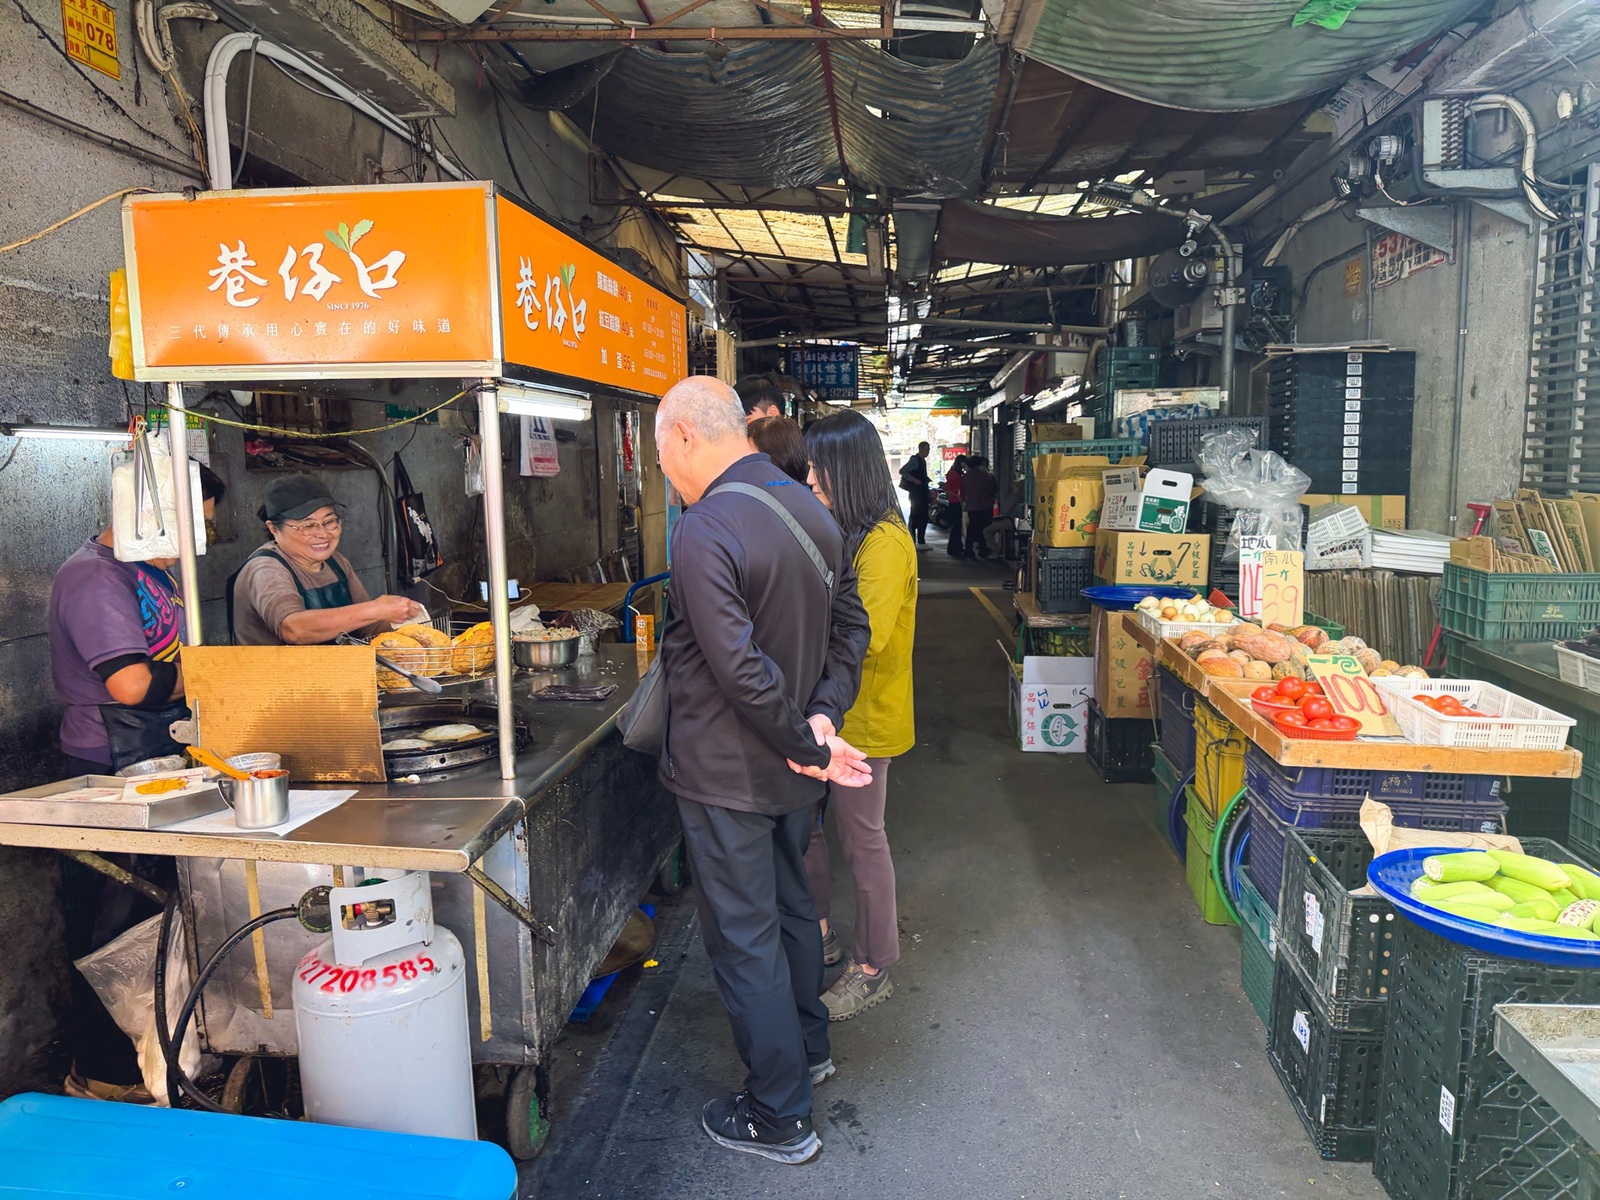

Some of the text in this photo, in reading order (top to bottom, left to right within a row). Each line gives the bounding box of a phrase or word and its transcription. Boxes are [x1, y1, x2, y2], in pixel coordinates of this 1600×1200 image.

[86, 22, 114, 51] 078
[207, 239, 406, 307] 巷仔口
[326, 302, 369, 310] SINCE 1976
[516, 256, 587, 342] 巷仔口
[169, 318, 452, 340] 三代傳承用心實在的好味道
[1241, 536, 1272, 550] 地瓜
[1264, 552, 1298, 567] 南瓜
[1266, 569, 1290, 582] 一斤
[1319, 673, 1388, 717] 100
